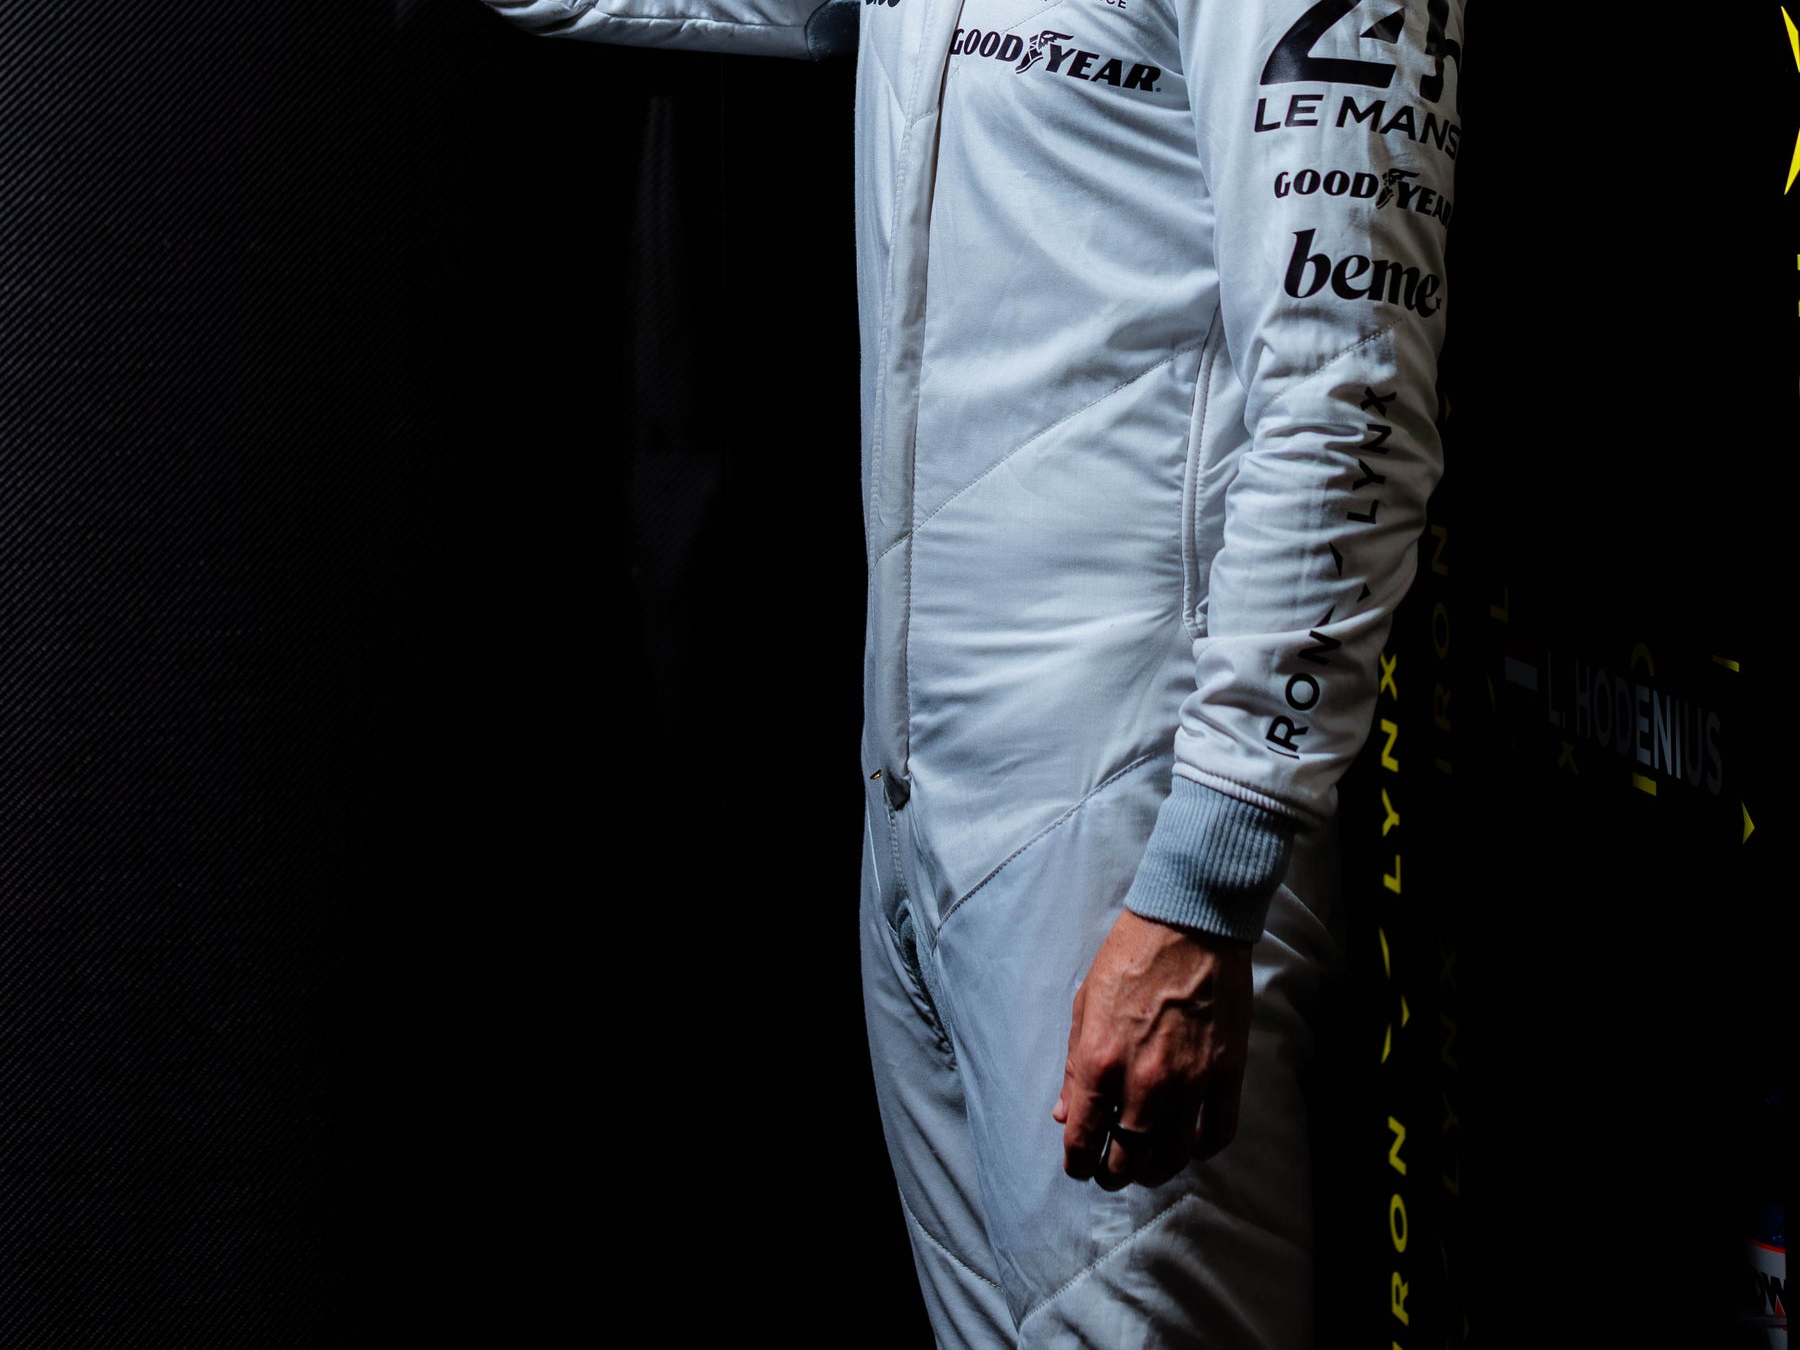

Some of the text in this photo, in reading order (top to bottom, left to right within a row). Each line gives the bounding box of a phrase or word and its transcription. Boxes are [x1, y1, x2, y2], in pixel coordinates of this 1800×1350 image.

[1254, 94, 1460, 161] LE MANS
[1284, 228, 1442, 318] beme
[1346, 386, 1398, 525] LYNX
[1379, 653, 1402, 895] LYNX
